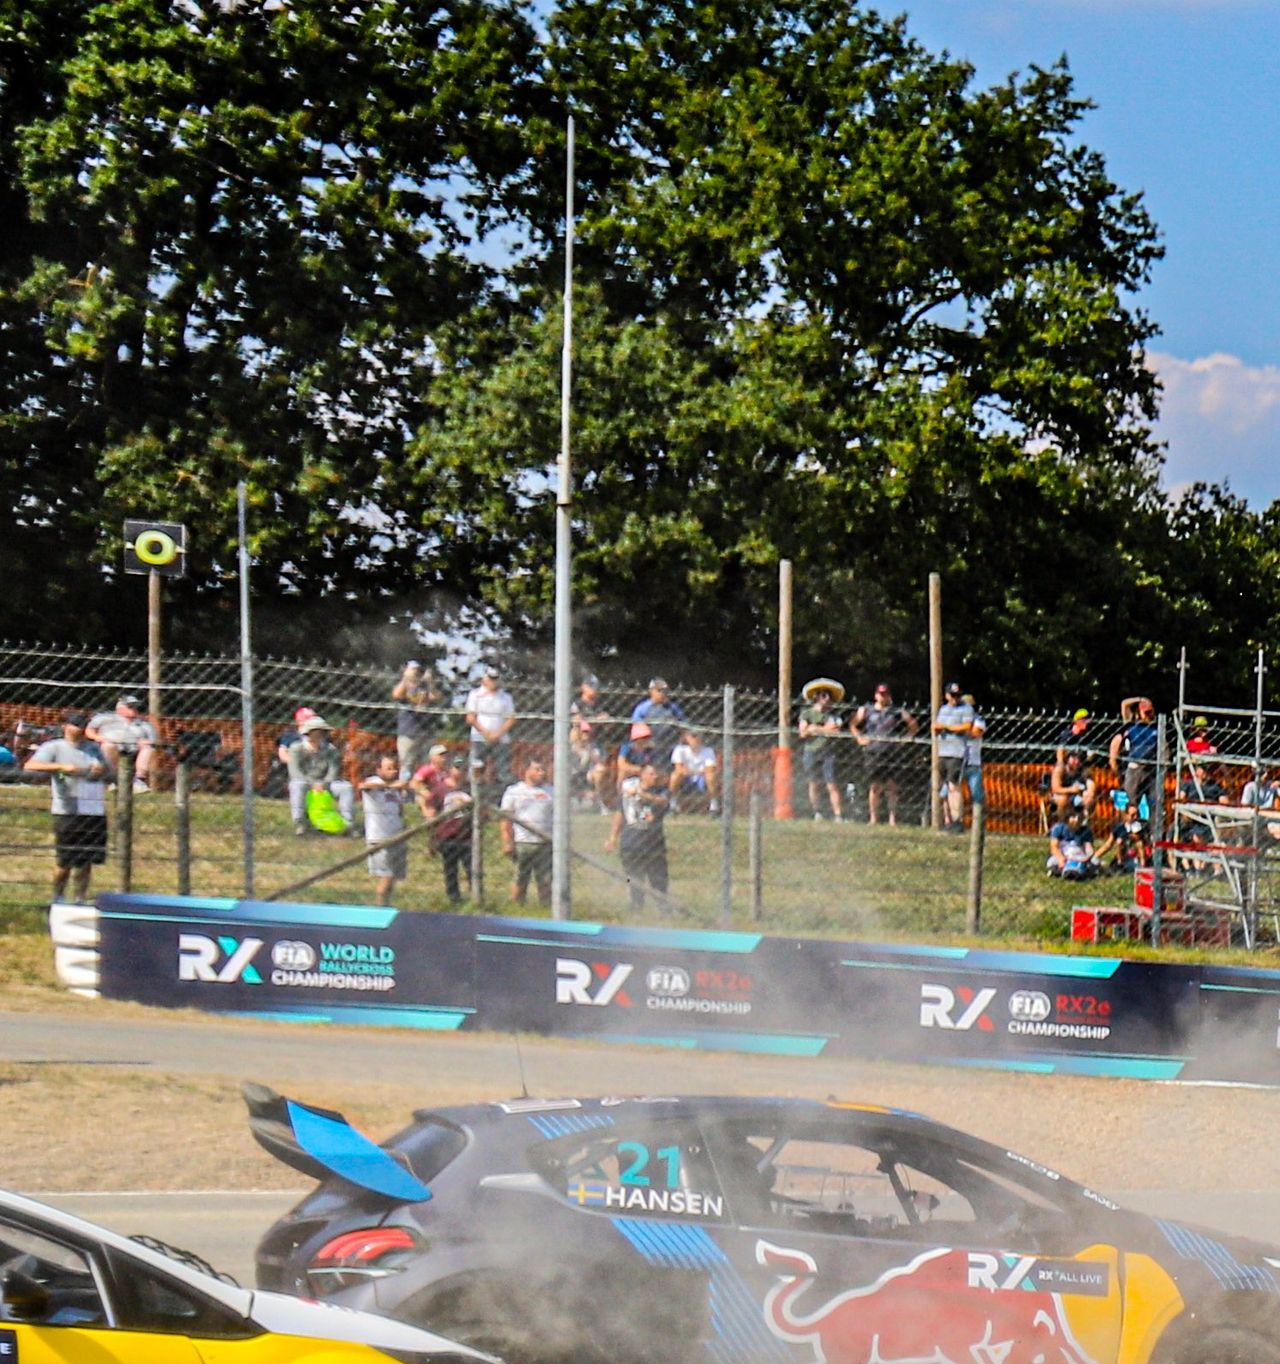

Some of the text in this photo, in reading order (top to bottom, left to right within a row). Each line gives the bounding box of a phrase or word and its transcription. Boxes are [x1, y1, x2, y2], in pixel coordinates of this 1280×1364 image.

[135, 530, 176, 565] O
[179, 934, 264, 983] RX
[273, 942, 312, 965] FIA
[320, 942, 394, 963] WORLD
[271, 971, 395, 991] CHAMPIONSHIP
[556, 957, 633, 1007] RX
[647, 971, 688, 994] FIA
[647, 998, 751, 1015] CHAMPIONSHIP
[920, 984, 997, 1032] RX
[1010, 994, 1049, 1017] FIA
[1008, 1021, 1111, 1040] CHAMPIONSHIP
[618, 1142, 682, 1189] 21
[606, 1186, 723, 1217] HANSEN
[968, 1253, 1037, 1291] RX
[1079, 1273, 1102, 1284] LIVE
